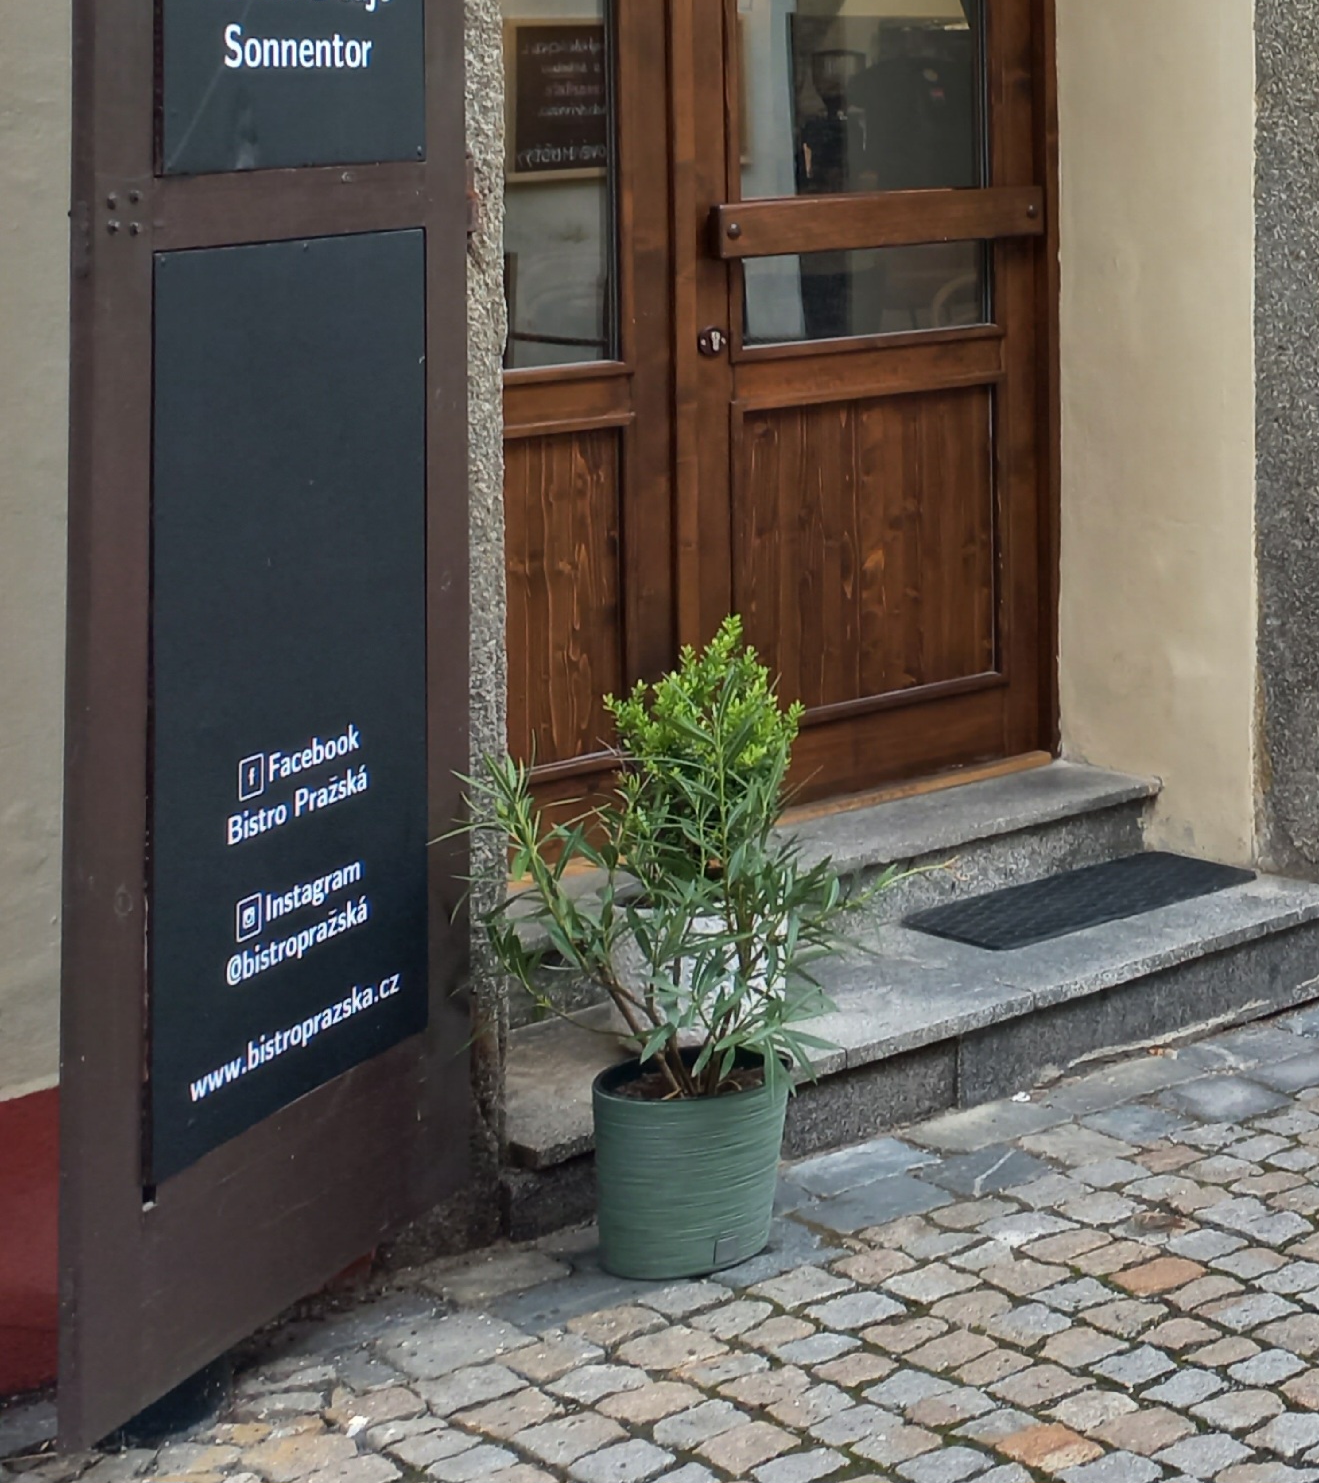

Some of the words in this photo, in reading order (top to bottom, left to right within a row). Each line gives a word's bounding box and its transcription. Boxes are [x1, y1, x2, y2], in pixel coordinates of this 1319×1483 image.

[223, 23, 372, 69] Sonnentor
[268, 723, 361, 784] Facebook
[226, 800, 287, 846] Bistro
[265, 859, 362, 924] Instagram
[189, 971, 401, 1102] www.bistroprazska.cz
